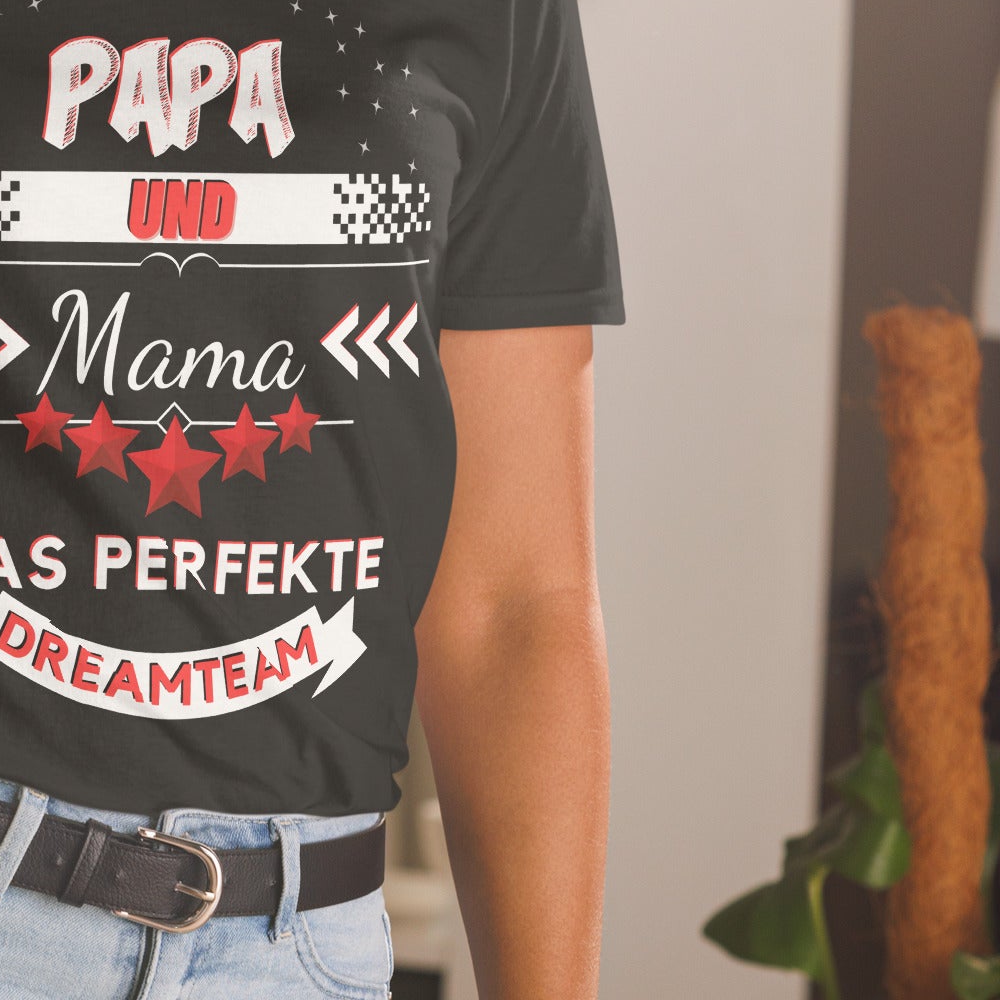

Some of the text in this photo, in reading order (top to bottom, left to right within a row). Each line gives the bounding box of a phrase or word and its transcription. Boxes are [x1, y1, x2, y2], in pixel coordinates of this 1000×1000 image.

[42, 36, 295, 158] PAPA
[127, 178, 237, 241] UND
[36, 289, 306, 396] Mama
[93, 534, 384, 595] PERFEKTE
